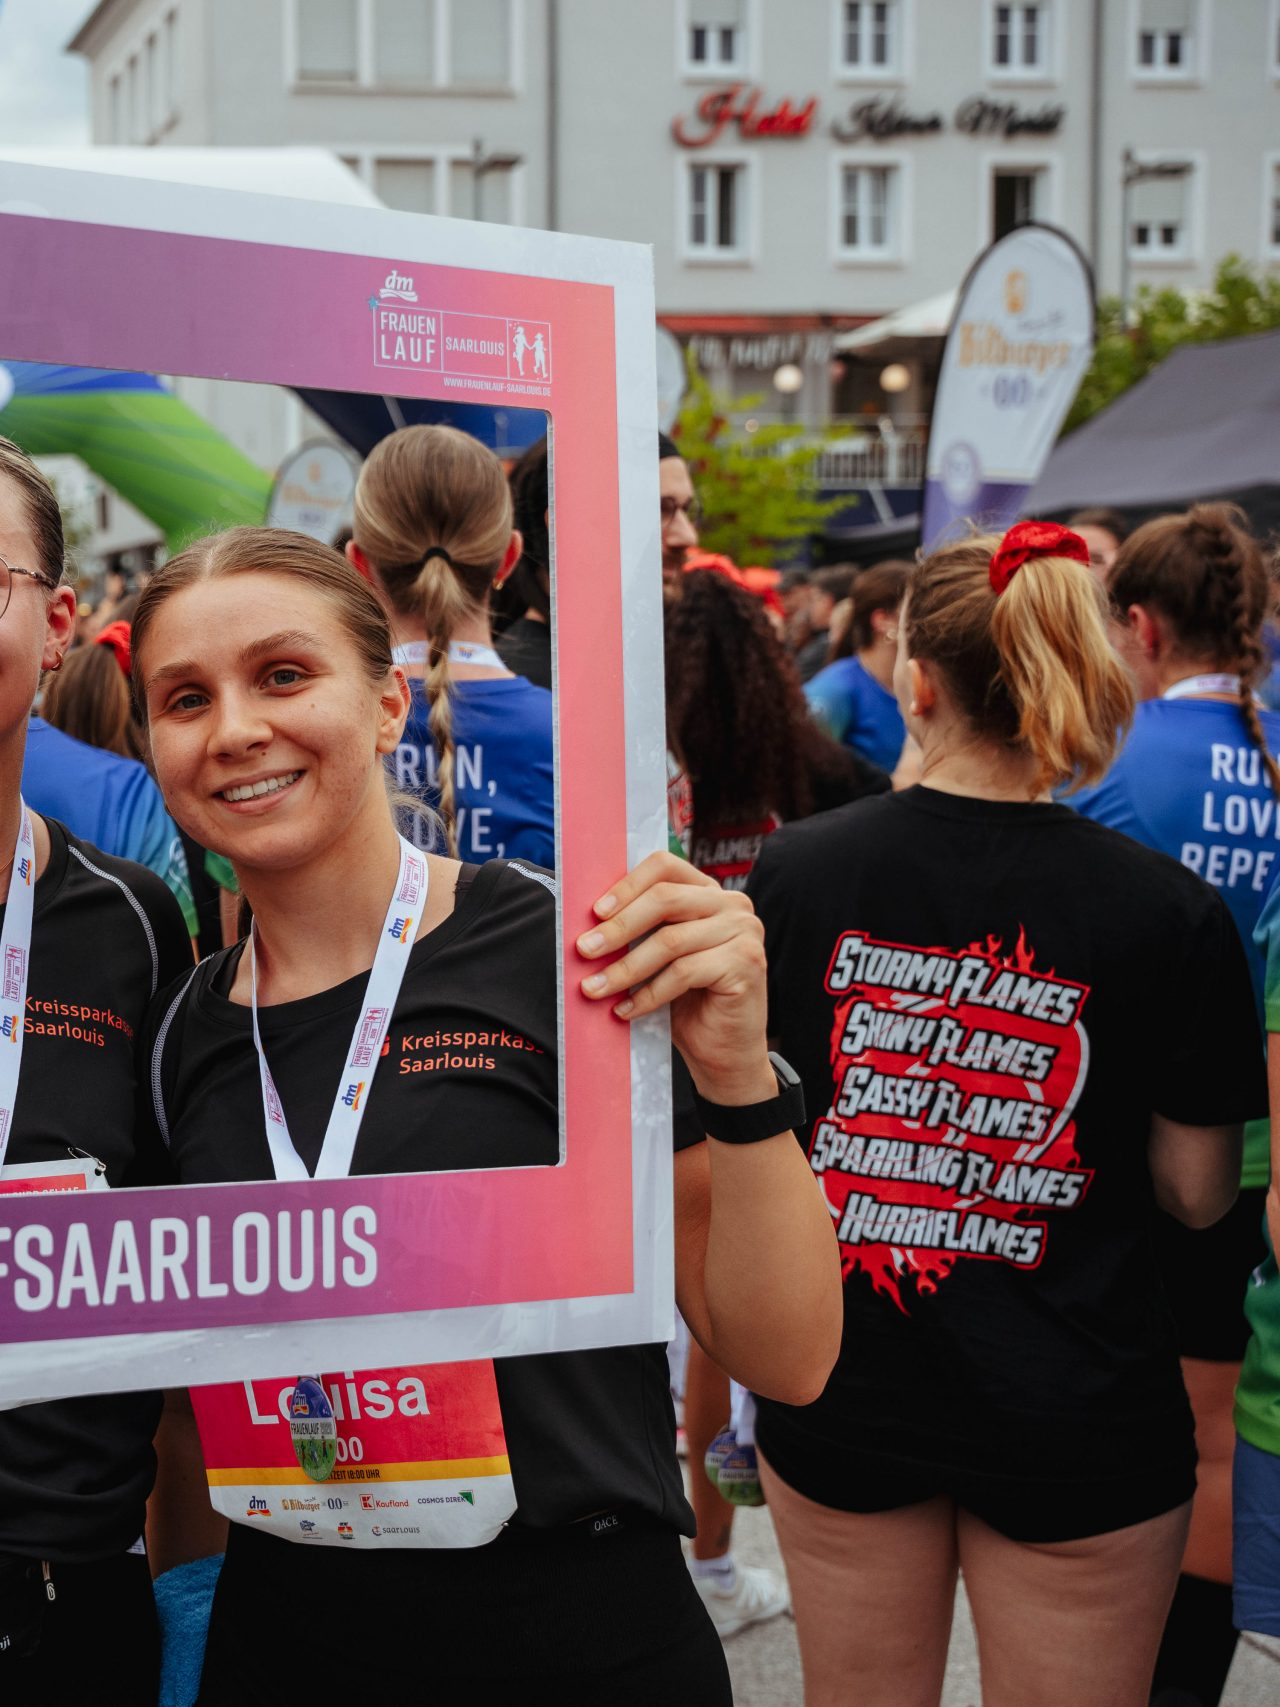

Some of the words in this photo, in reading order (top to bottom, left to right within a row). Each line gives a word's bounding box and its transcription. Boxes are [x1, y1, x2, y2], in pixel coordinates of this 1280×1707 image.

[385, 270, 413, 290] dm
[380, 312, 436, 335] FRAUEN
[381, 335, 436, 363] LAUF
[446, 336, 505, 356] SAARLOUIS
[18, 858, 28, 879] dm
[388, 917, 405, 939] dm
[0, 1015, 13, 1037] dm
[24, 1017, 105, 1047] Saarlouis
[402, 1030, 544, 1054] Kreissparkas
[360, 1047, 371, 1065] LAUF
[399, 1053, 496, 1074] Saarlouis
[342, 1084, 358, 1106] dm
[243, 1370, 431, 1425] Lisa
[291, 1422, 319, 1435] FRAUENLAUF
[348, 1469, 364, 1479] 18:00
[366, 1468, 380, 1479] UHR
[249, 1496, 267, 1509] dm
[375, 1499, 409, 1508] Kaufland
[417, 1496, 445, 1504] COSMOS
